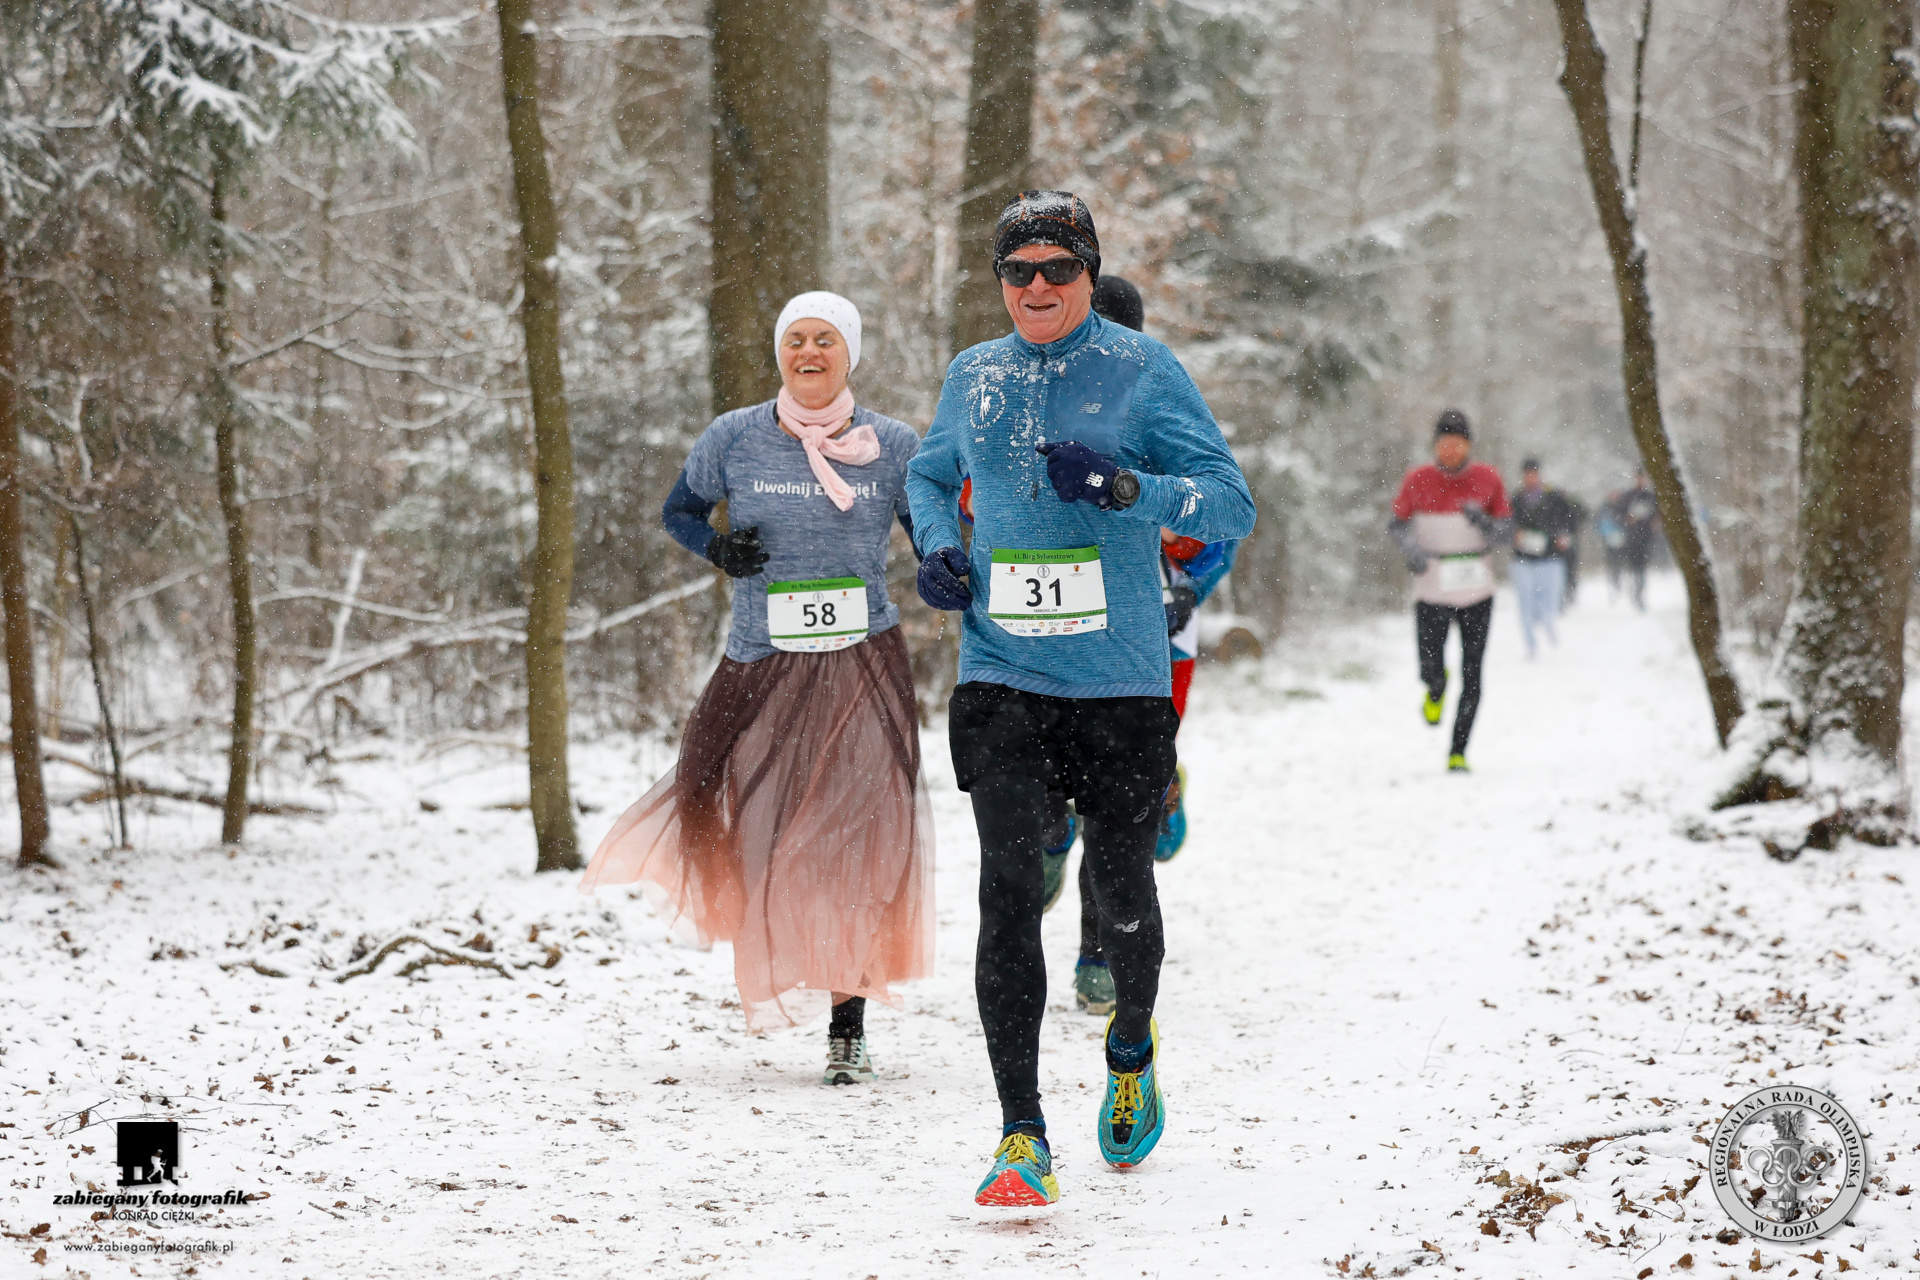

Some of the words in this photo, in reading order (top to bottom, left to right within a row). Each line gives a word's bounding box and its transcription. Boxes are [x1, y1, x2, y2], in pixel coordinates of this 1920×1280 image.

[753, 480, 810, 498] Uwolnij
[1025, 577, 1062, 607] 31
[802, 602, 837, 628] 58
